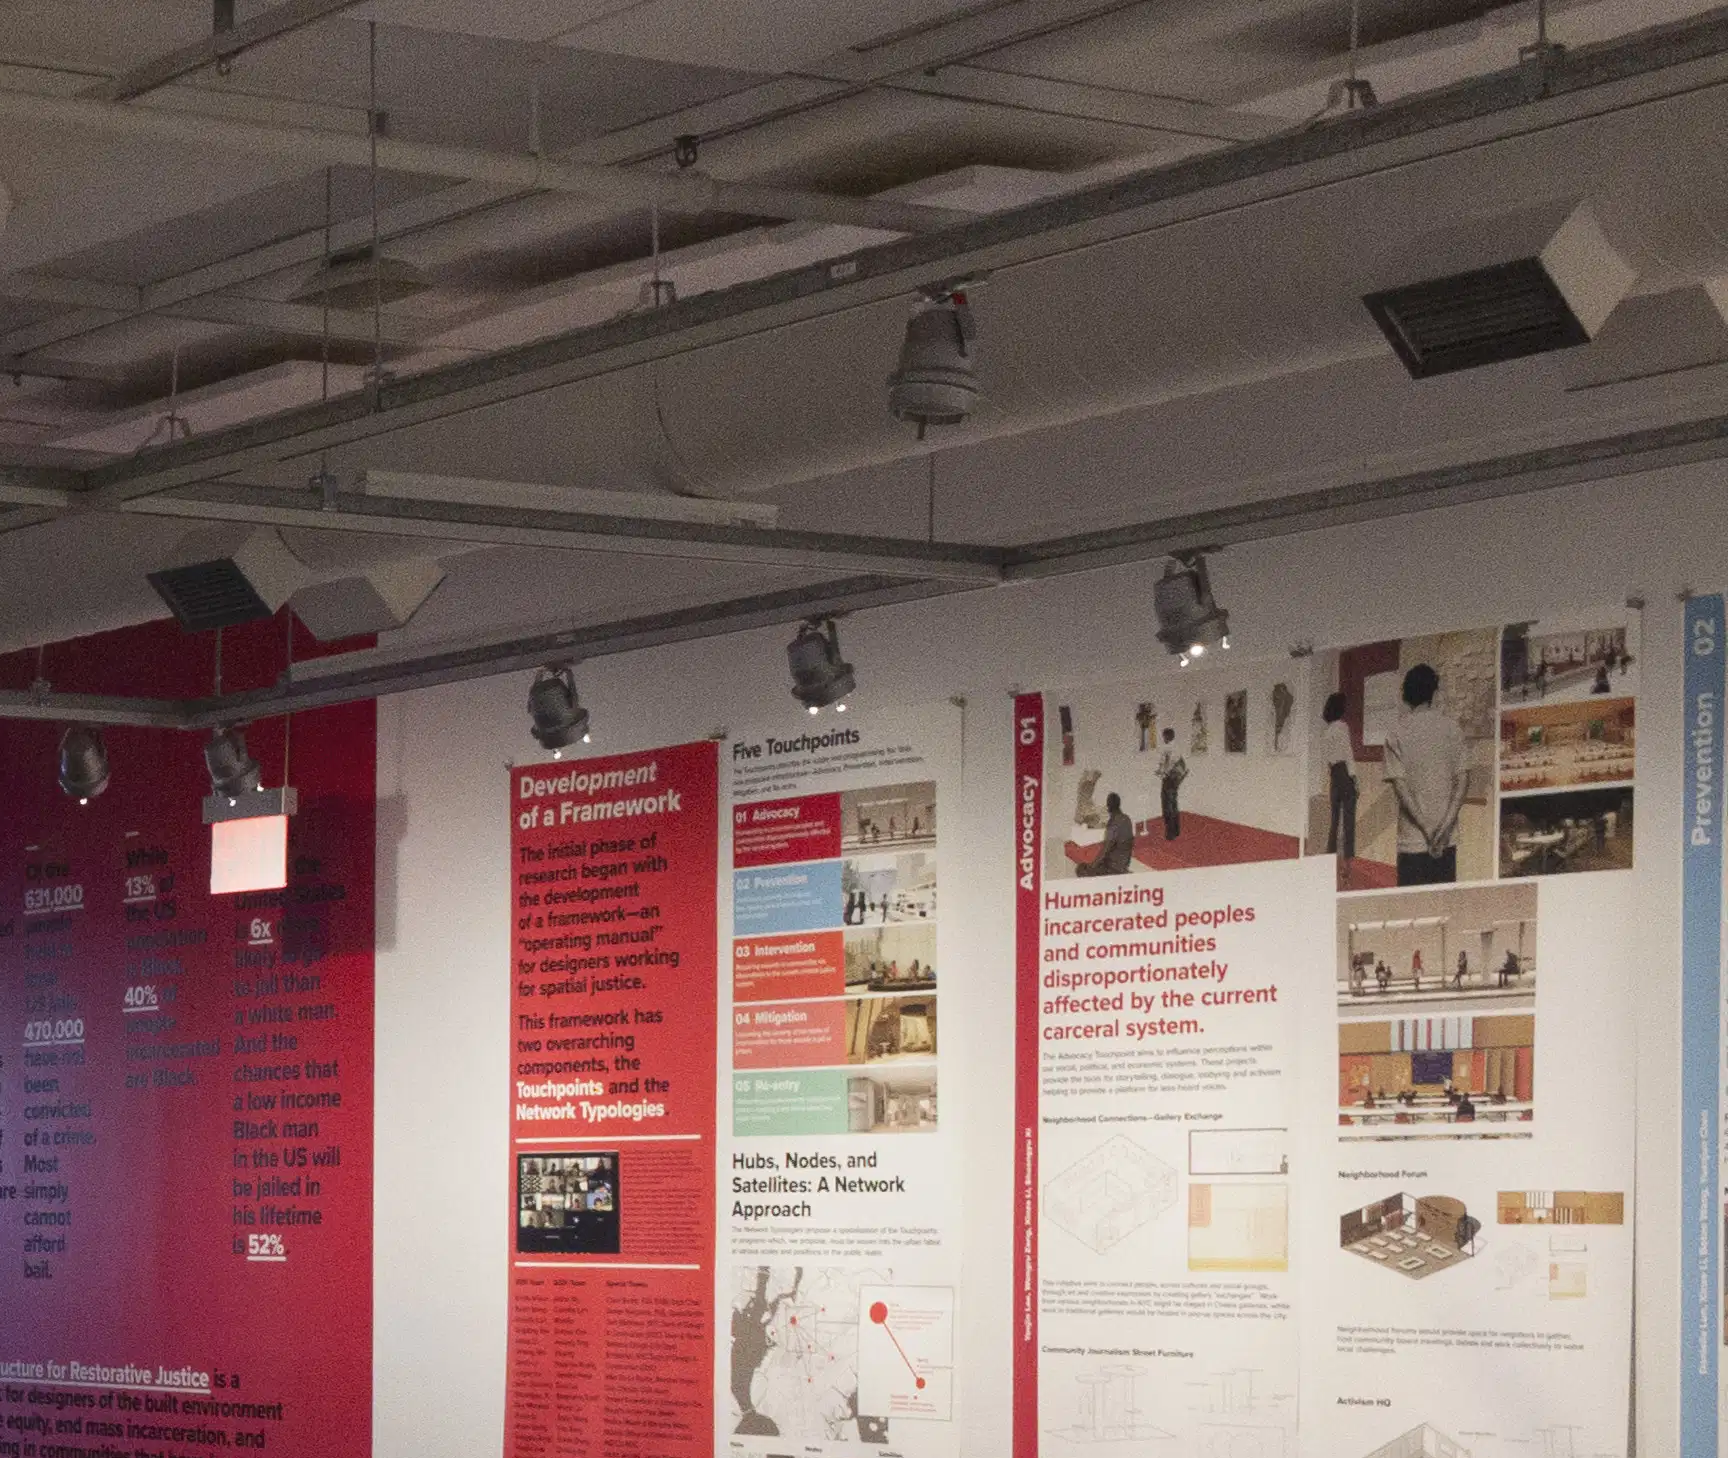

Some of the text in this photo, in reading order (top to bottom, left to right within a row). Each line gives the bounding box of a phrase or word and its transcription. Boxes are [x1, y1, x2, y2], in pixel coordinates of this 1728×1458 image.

[733, 727, 860, 760] Five Touchpoints
[1691, 617, 1715, 847] Prevention 02
[520, 762, 657, 799] Development
[519, 792, 680, 830] of a Framework
[736, 806, 800, 823] 01 Advocacy
[1019, 716, 1038, 891] Advocacy 01
[520, 834, 657, 863] The initial phase of
[520, 856, 667, 885] research began with
[24, 884, 84, 910] 631,000
[125, 875, 156, 898] 13%
[519, 884, 639, 909] the development
[1044, 884, 1164, 911] Humanizing
[250, 918, 273, 939] 6x
[519, 913, 532, 930] of
[536, 916, 544, 929] a
[1044, 905, 1255, 937] incarcerated peoples
[736, 941, 815, 957] 03 Intervention
[1043, 936, 1216, 962] and communities
[519, 949, 679, 976] for designers working
[519, 974, 645, 999] for spatial justice.
[1043, 961, 1229, 991] disproportionately
[124, 985, 159, 1007] 40%
[1043, 985, 1278, 1015] affected by the current
[519, 1009, 663, 1030] This framework has
[736, 1010, 807, 1025] 04 Mitigation
[23, 1020, 84, 1041] 470,000
[1043, 1019, 1205, 1041] carceral system.
[518, 1032, 635, 1056] two overarching
[518, 1055, 640, 1079] components, the
[516, 1077, 669, 1103] Touchpoints and the
[516, 1102, 575, 1121] Network
[1042, 1115, 1096, 1125] Neighborhood
[1184, 1112, 1224, 1122] Exchange
[732, 1152, 877, 1172] Hubs, Nodes, and
[732, 1176, 904, 1194] Satellites: A Network
[1338, 1169, 1427, 1180] Neighborhood Forum
[732, 1201, 811, 1221] Approach
[248, 1234, 285, 1255] 52%
[1042, 1345, 1194, 1358] Community Journalism Street Furniture
[47, 1360, 67, 1380] for
[70, 1361, 152, 1384] Restorative
[154, 1367, 209, 1388] Justice
[1337, 1396, 1392, 1408] Activism HQ
